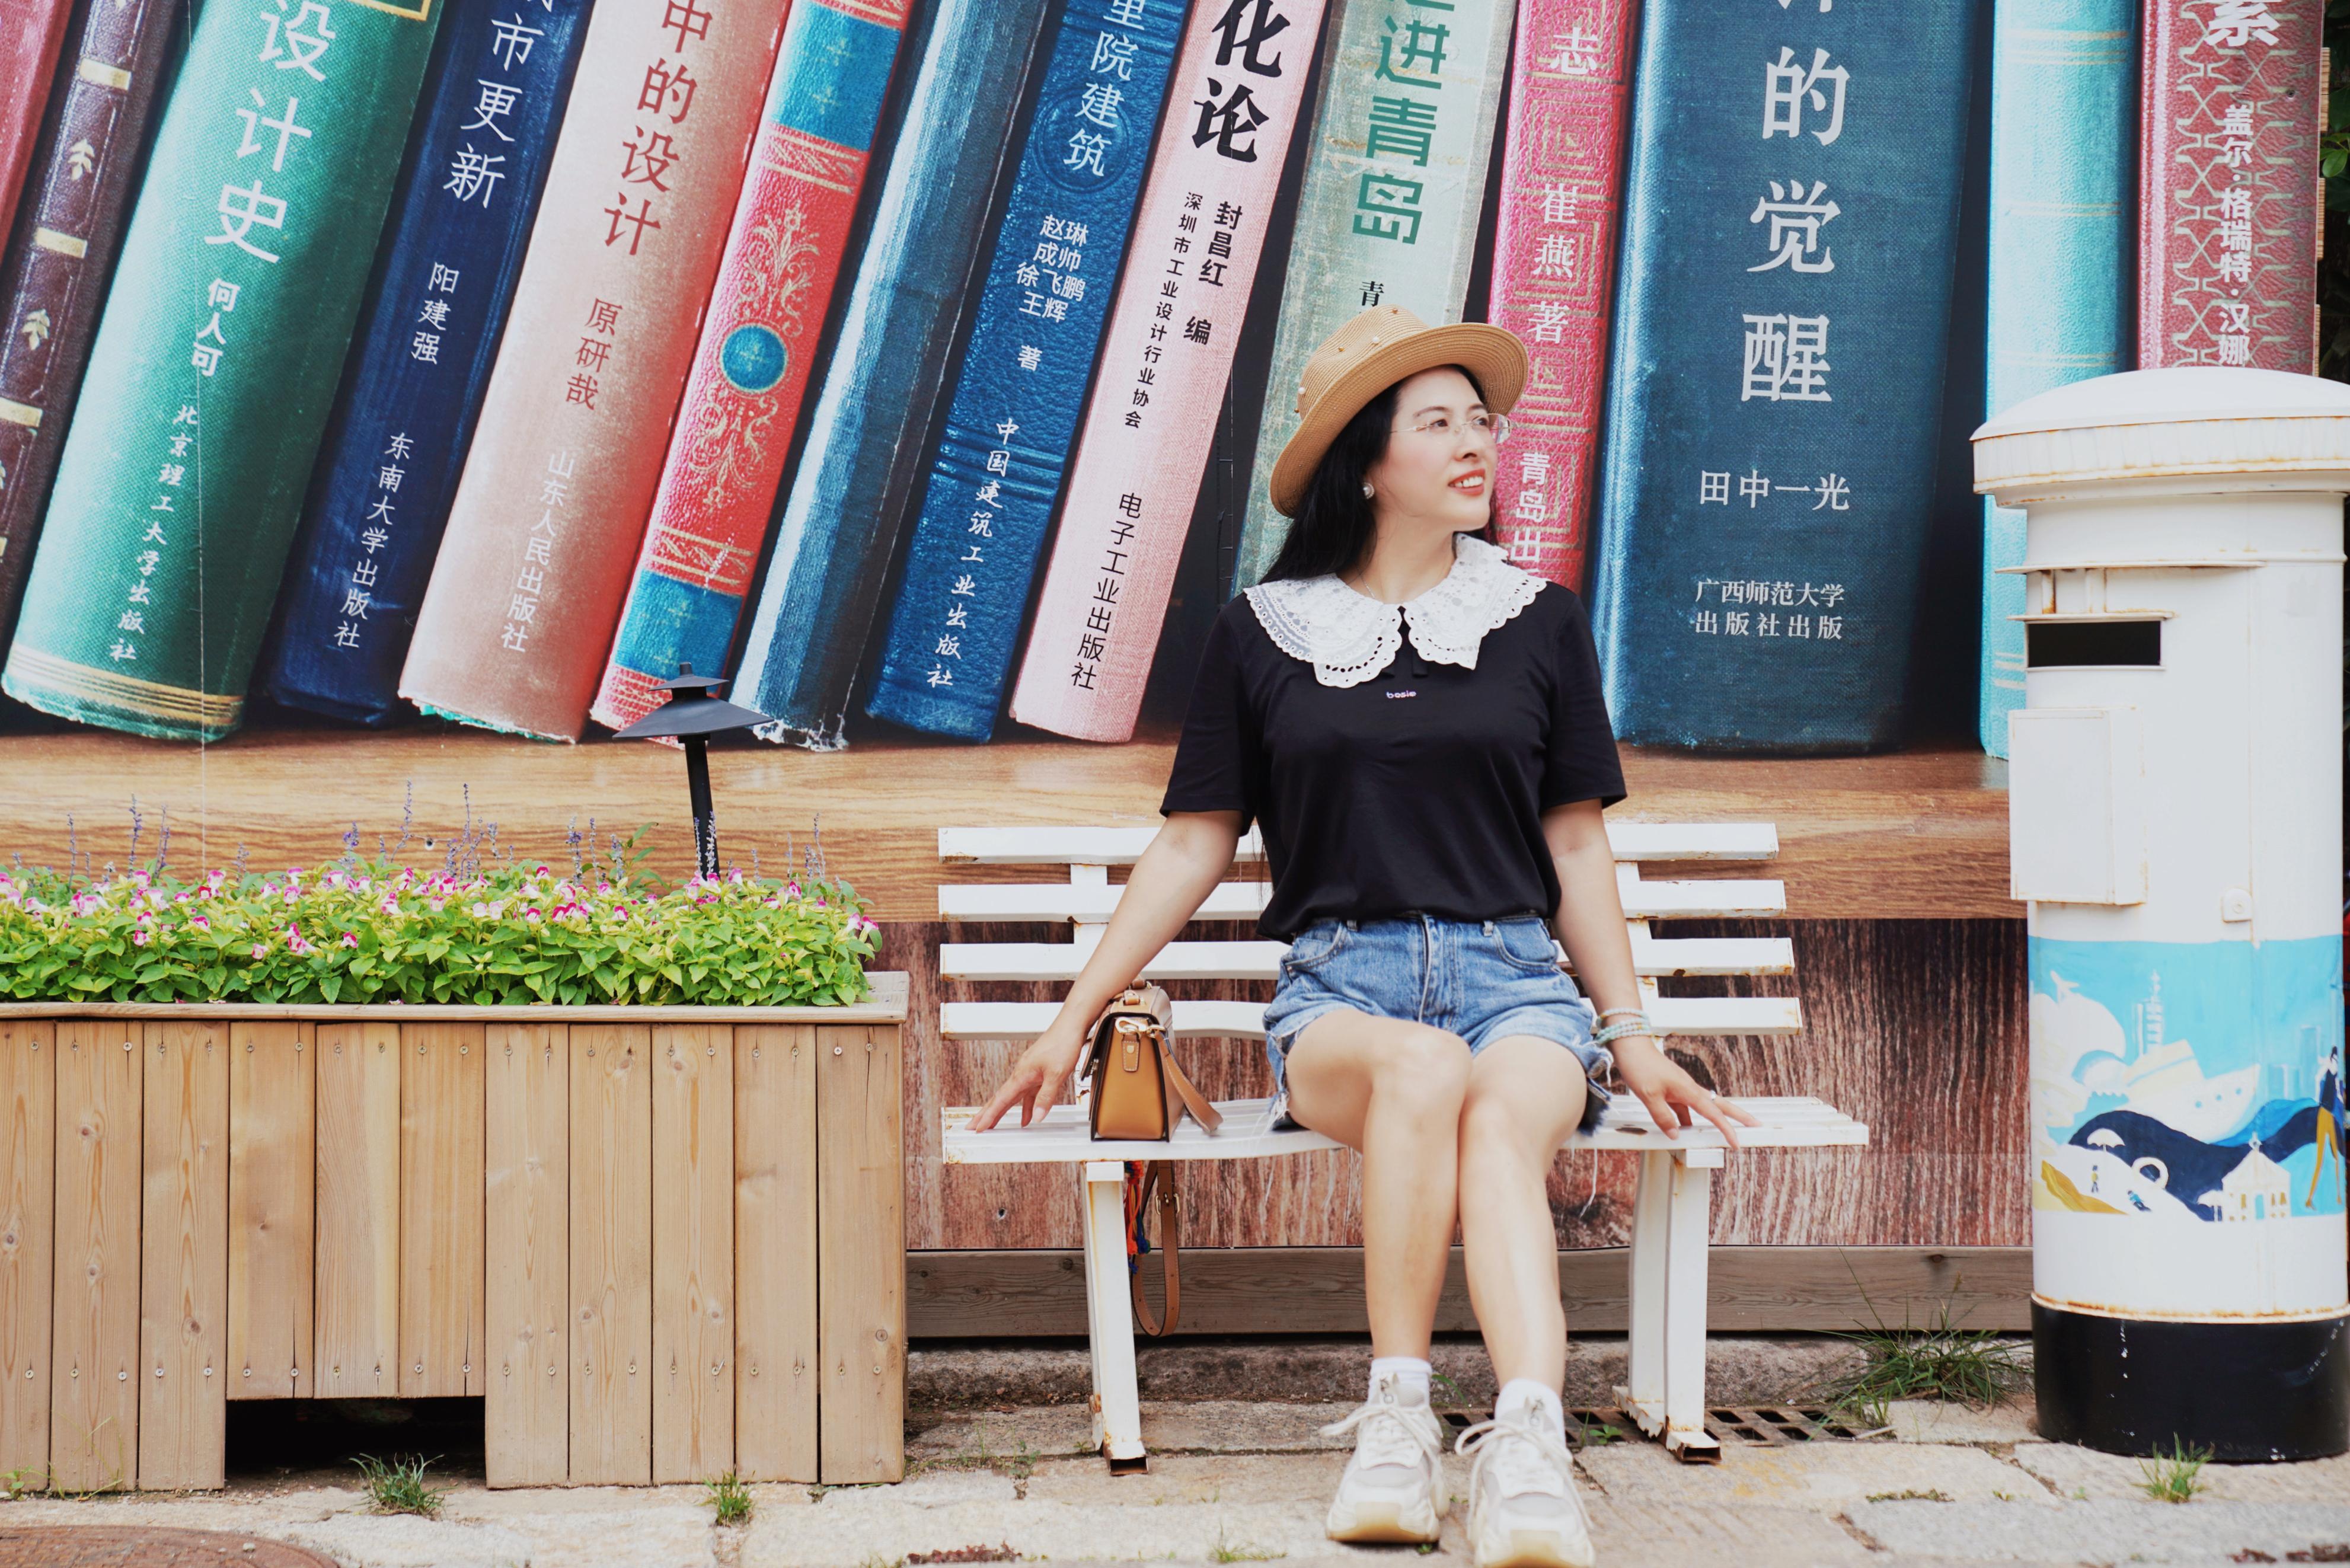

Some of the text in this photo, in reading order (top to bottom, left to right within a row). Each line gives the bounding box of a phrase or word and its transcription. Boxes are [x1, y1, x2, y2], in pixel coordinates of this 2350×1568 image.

[205, 0, 336, 263] 设计史
[443, 0, 553, 208] 市更新
[604, 0, 713, 256] 中的设计
[1192, 0, 1291, 163] 化论
[1352, 0, 1455, 245] 进青岛
[1359, 280, 1384, 314] 青
[1741, 0, 1850, 403] 的觉醒
[193, 279, 240, 377] 何人可
[411, 262, 459, 365] 阳建强
[566, 298, 622, 410] 原研哉
[1125, 192, 1203, 429] 深圳市工业设计行业协会
[110, 405, 198, 662] 北京理工大学出版社
[334, 432, 413, 648] 东南大学出版社
[501, 451, 576, 653] 山东人民出版社
[927, 418, 1019, 688] 中国建筑工业出版社
[1510, 452, 1551, 576] 青岛出
[1700, 468, 1850, 511] 田中一光
[1071, 492, 1142, 691] 电子工业出版社
[1694, 610, 1843, 640] 出版社出版
[1696, 578, 1844, 608] 广西师范大学
